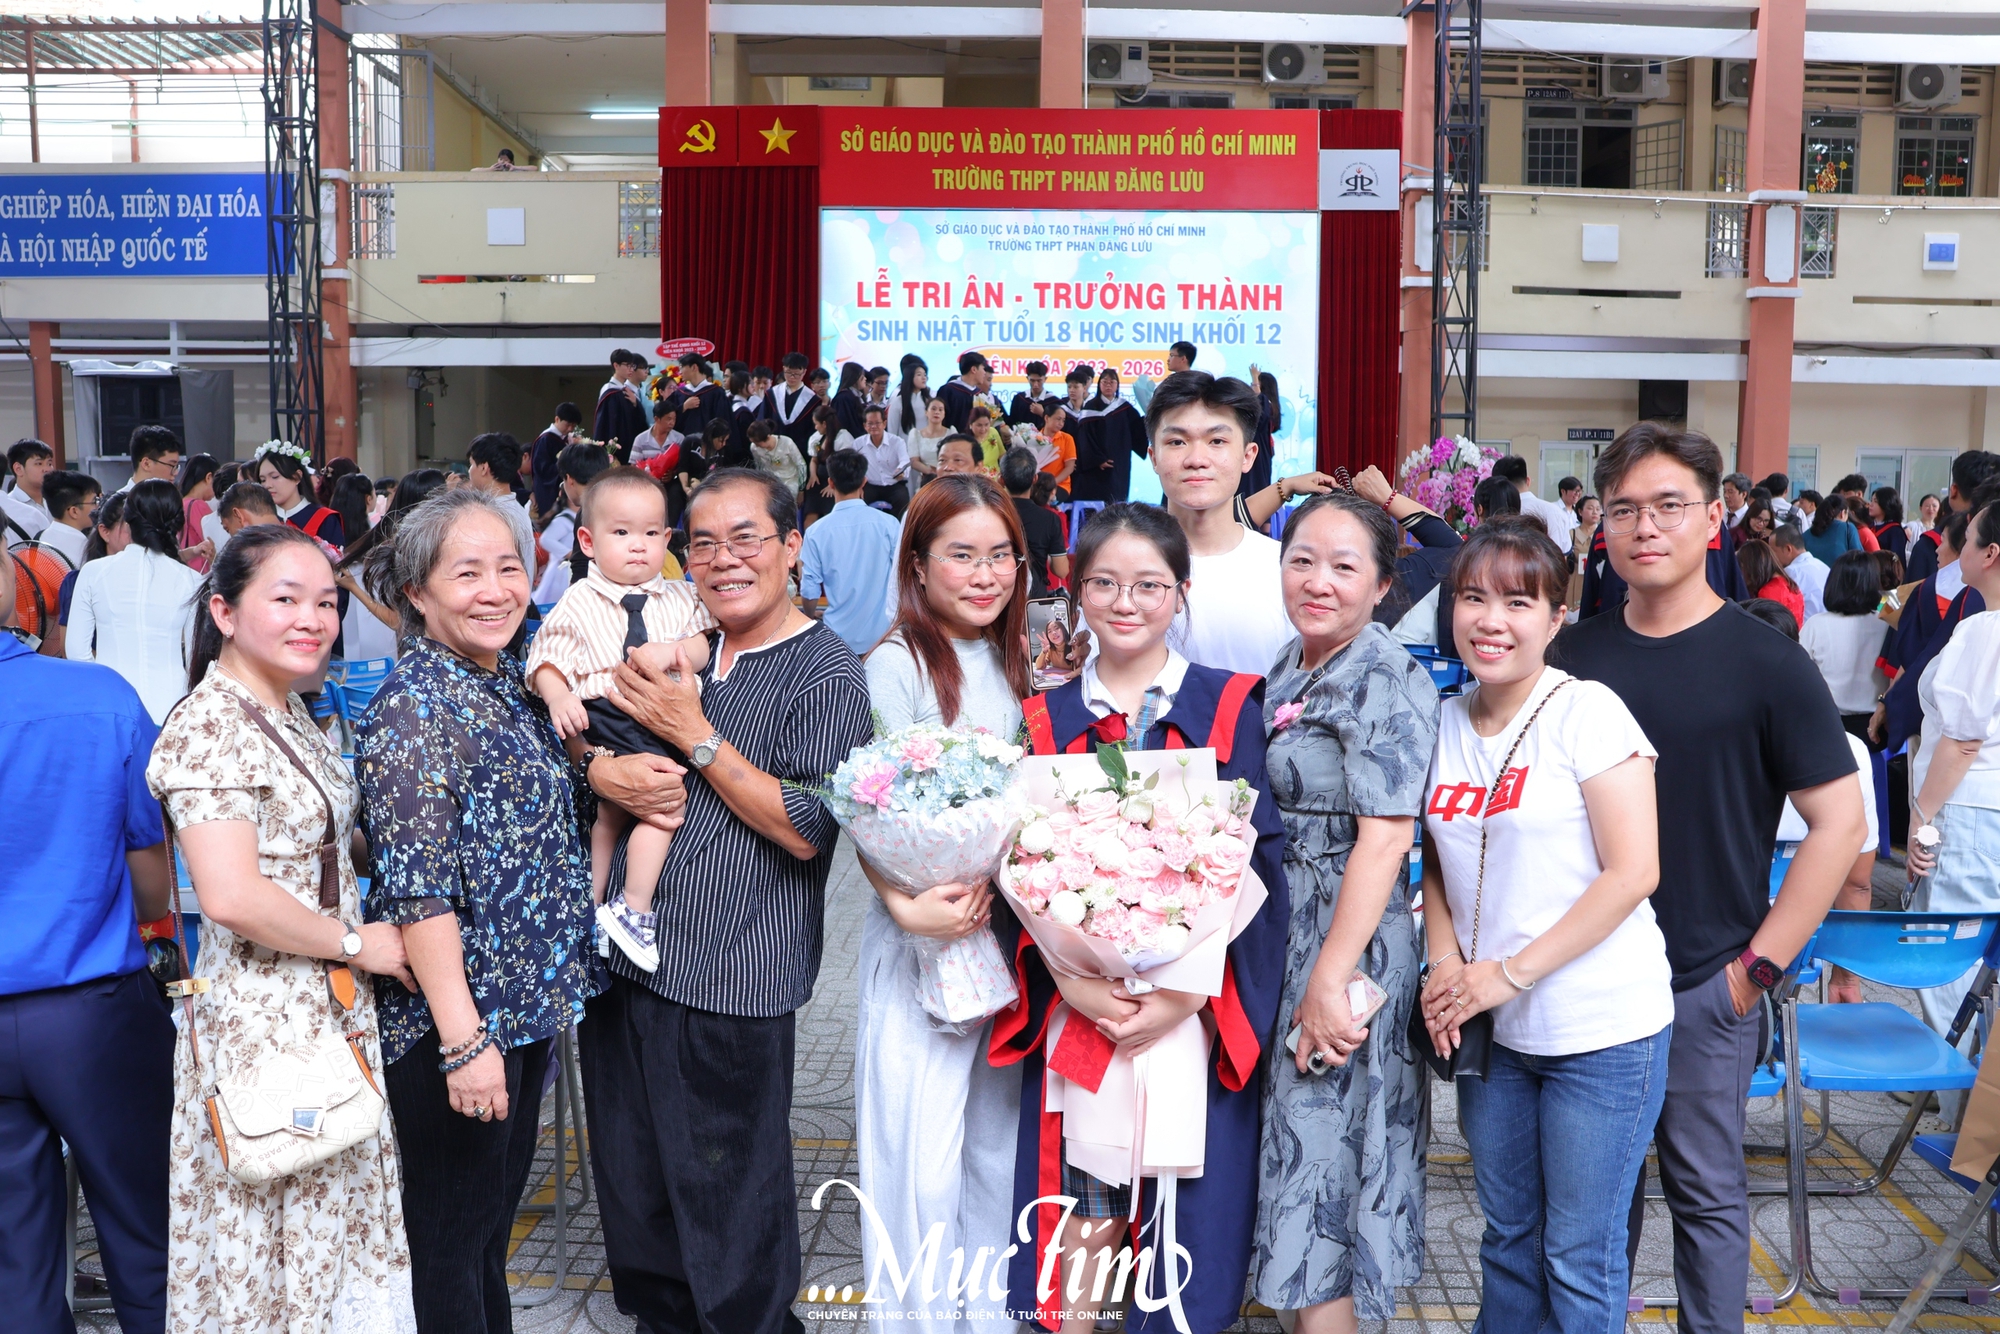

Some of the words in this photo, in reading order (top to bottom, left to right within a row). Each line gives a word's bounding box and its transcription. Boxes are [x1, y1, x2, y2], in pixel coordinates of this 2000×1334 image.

[840, 124, 864, 152] SỞ
[869, 126, 912, 152] GIÁO
[918, 131, 955, 158] DỤC
[960, 128, 984, 154] VÀ
[989, 128, 1026, 154] ĐÀO
[1031, 133, 1066, 159] TẠO
[1071, 129, 1131, 155] THÀNH
[1137, 127, 1176, 156] PHỐ
[1180, 127, 1206, 156] HỒ
[1211, 129, 1244, 156] CHÍ
[1249, 134, 1296, 156] MINH
[932, 164, 1004, 191] TRƯỜNG
[1010, 170, 1055, 191] THPT
[1061, 170, 1109, 192] PHAN
[1115, 167, 1164, 192] ĐĂNG
[1170, 168, 1204, 192] LƯU
[0, 188, 62, 224] GHIỆP
[67, 187, 115, 221] HÓA,
[121, 187, 171, 223] HIỆN
[177, 193, 213, 223] ĐẠI
[218, 186, 262, 217] HÓA
[19, 232, 56, 268] HỘI
[61, 231, 116, 268] NHẬP
[121, 226, 176, 268] QUỐC
[181, 226, 208, 261] TẾ
[935, 220, 950, 235] SỞ
[953, 222, 978, 235] GIÁO
[981, 224, 1003, 238] DỤC
[1006, 222, 1020, 235] VÀ
[1023, 222, 1045, 235] ĐÀO
[1049, 224, 1070, 238] TẠO
[1073, 222, 1109, 236] THÀNH
[1113, 221, 1136, 236] PHỐ
[1156, 223, 1175, 236] CHÍ
[1178, 226, 1206, 237] MINH
[988, 238, 1032, 251] TRƯỜNG
[1035, 240, 1063, 251] THPT
[1066, 241, 1095, 252] PHAN
[1099, 239, 1128, 252] ĐĂNG
[1131, 240, 1153, 252] LƯU
[857, 267, 891, 308] LỄ
[903, 281, 950, 308] TRI
[962, 274, 1004, 308] ÂN
[1033, 271, 1166, 310] TRƯỞNG
[1177, 277, 1283, 311] THÀNH
[857, 319, 908, 342] SINH
[918, 314, 976, 347] NHẬT
[984, 309, 1035, 343] TUỔI
[1045, 321, 1071, 342] 18
[1079, 321, 1124, 347] HỌC
[1132, 322, 1183, 344] SINH
[1192, 314, 1245, 344] KHỐI
[1255, 323, 1282, 345] 12
[986, 355, 1011, 375] ÊN
[1018, 355, 1061, 375] KÓA
[1123, 361, 1164, 376] 2026
[1427, 765, 1529, 821] 中国
